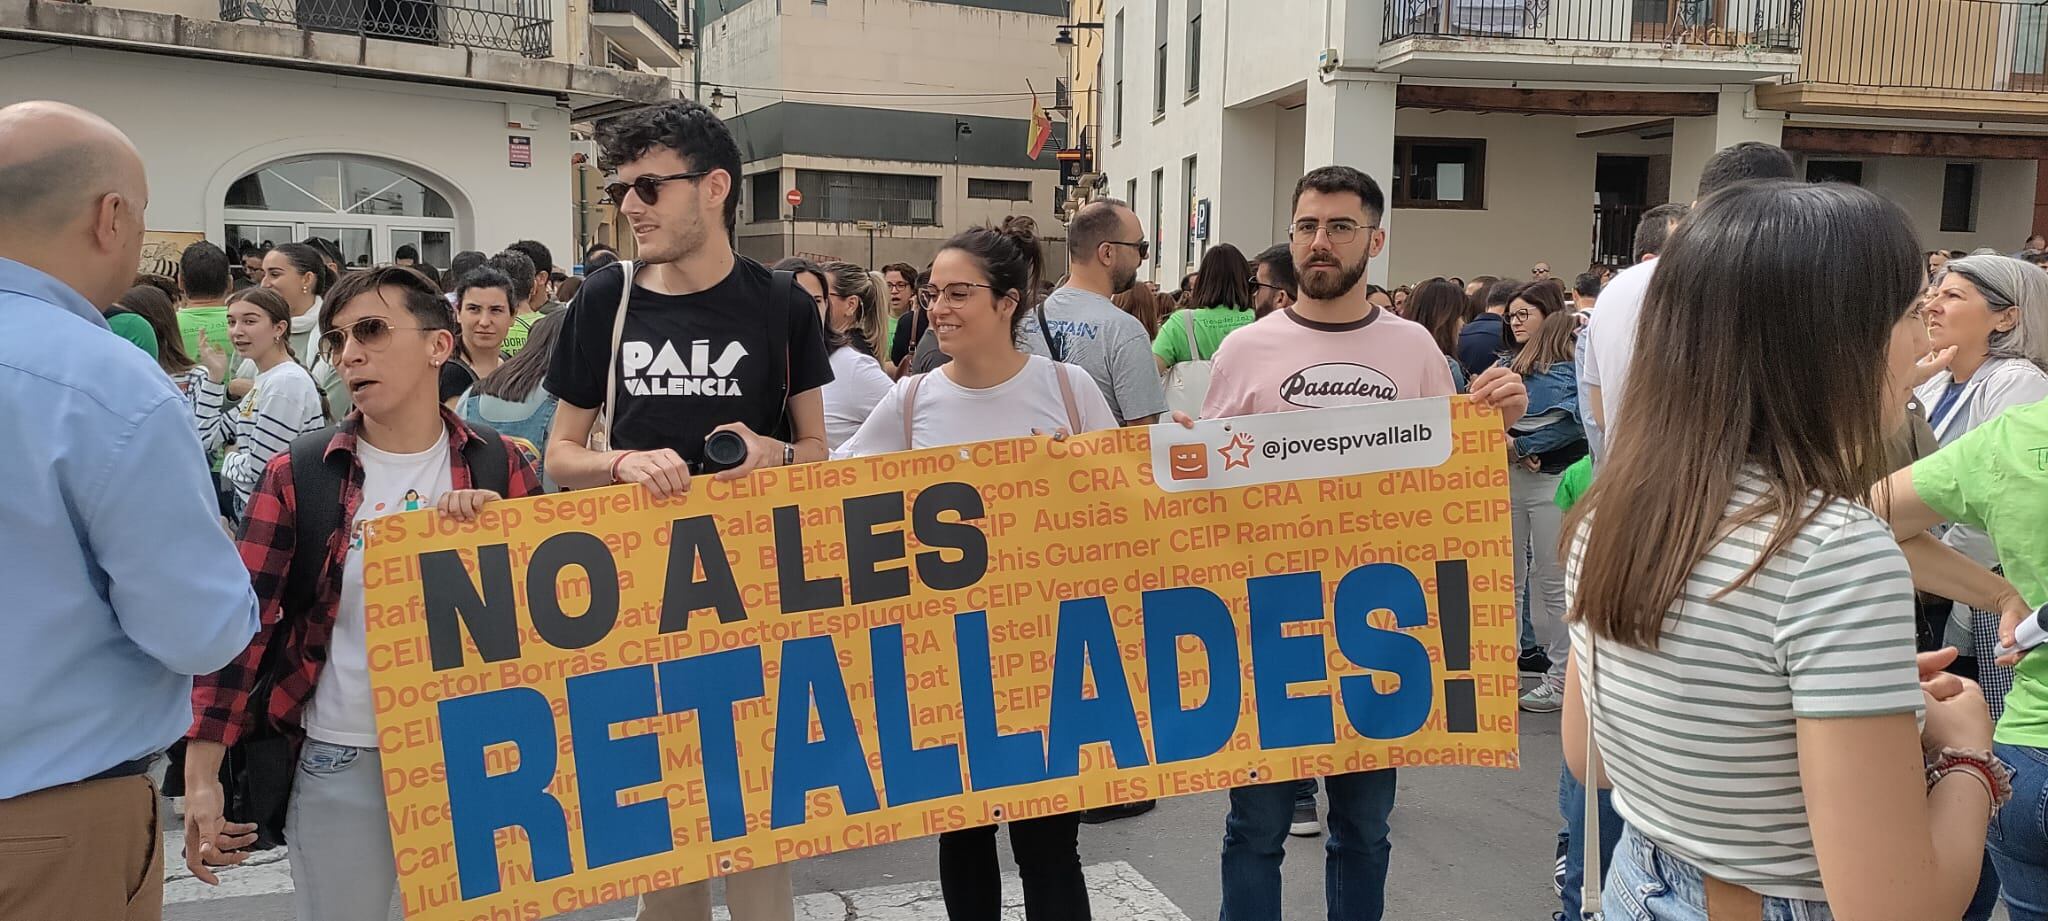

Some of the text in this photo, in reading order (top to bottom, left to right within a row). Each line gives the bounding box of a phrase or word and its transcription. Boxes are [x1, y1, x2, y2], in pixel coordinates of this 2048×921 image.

[623, 339, 749, 377] PAÍS
[624, 377, 743, 396] VALENCIÀ
[1281, 374, 1397, 401] Pasadena
[1262, 424, 1433, 460] @jovespvvallalb
[418, 506, 522, 539] Josep
[706, 471, 778, 501] CEIP
[788, 463, 857, 492] Elías
[864, 452, 955, 482] Tormo
[972, 438, 1037, 467] CEIP
[1046, 430, 1150, 460] Covalta
[1034, 500, 1129, 533] Ausiàs
[1143, 491, 1226, 521] March
[1242, 482, 1303, 510] CRA
[1318, 477, 1363, 503] Riu
[1377, 464, 1509, 496] d'Albaida
[1069, 466, 1130, 494] CRA
[1045, 537, 1160, 567] Guarner
[1169, 524, 1231, 551] CEIP
[1236, 514, 1334, 545] Ramón
[1339, 508, 1433, 535] Esteve
[1442, 498, 1512, 525] CEIP
[419, 481, 990, 673] NO A LES
[373, 671, 493, 715] Doctor
[499, 648, 608, 690] Borràs
[618, 633, 694, 664] CEIP
[699, 617, 803, 654] Doctor
[966, 581, 1033, 611] CEIP
[1123, 565, 1166, 593] del
[1172, 555, 1254, 588] Remei
[1264, 547, 1330, 575] CEIP
[1335, 540, 1438, 569] Mónica
[1443, 535, 1514, 561] Pont
[436, 557, 1478, 902] RETALLADES!
[551, 865, 686, 915] Guarner
[705, 846, 754, 879] IES
[775, 834, 833, 864] Pou
[841, 820, 903, 851] Clar
[921, 804, 967, 835] IES
[1104, 775, 1149, 804] IES
[1290, 753, 1335, 780] IES
[1344, 749, 1379, 771] de
